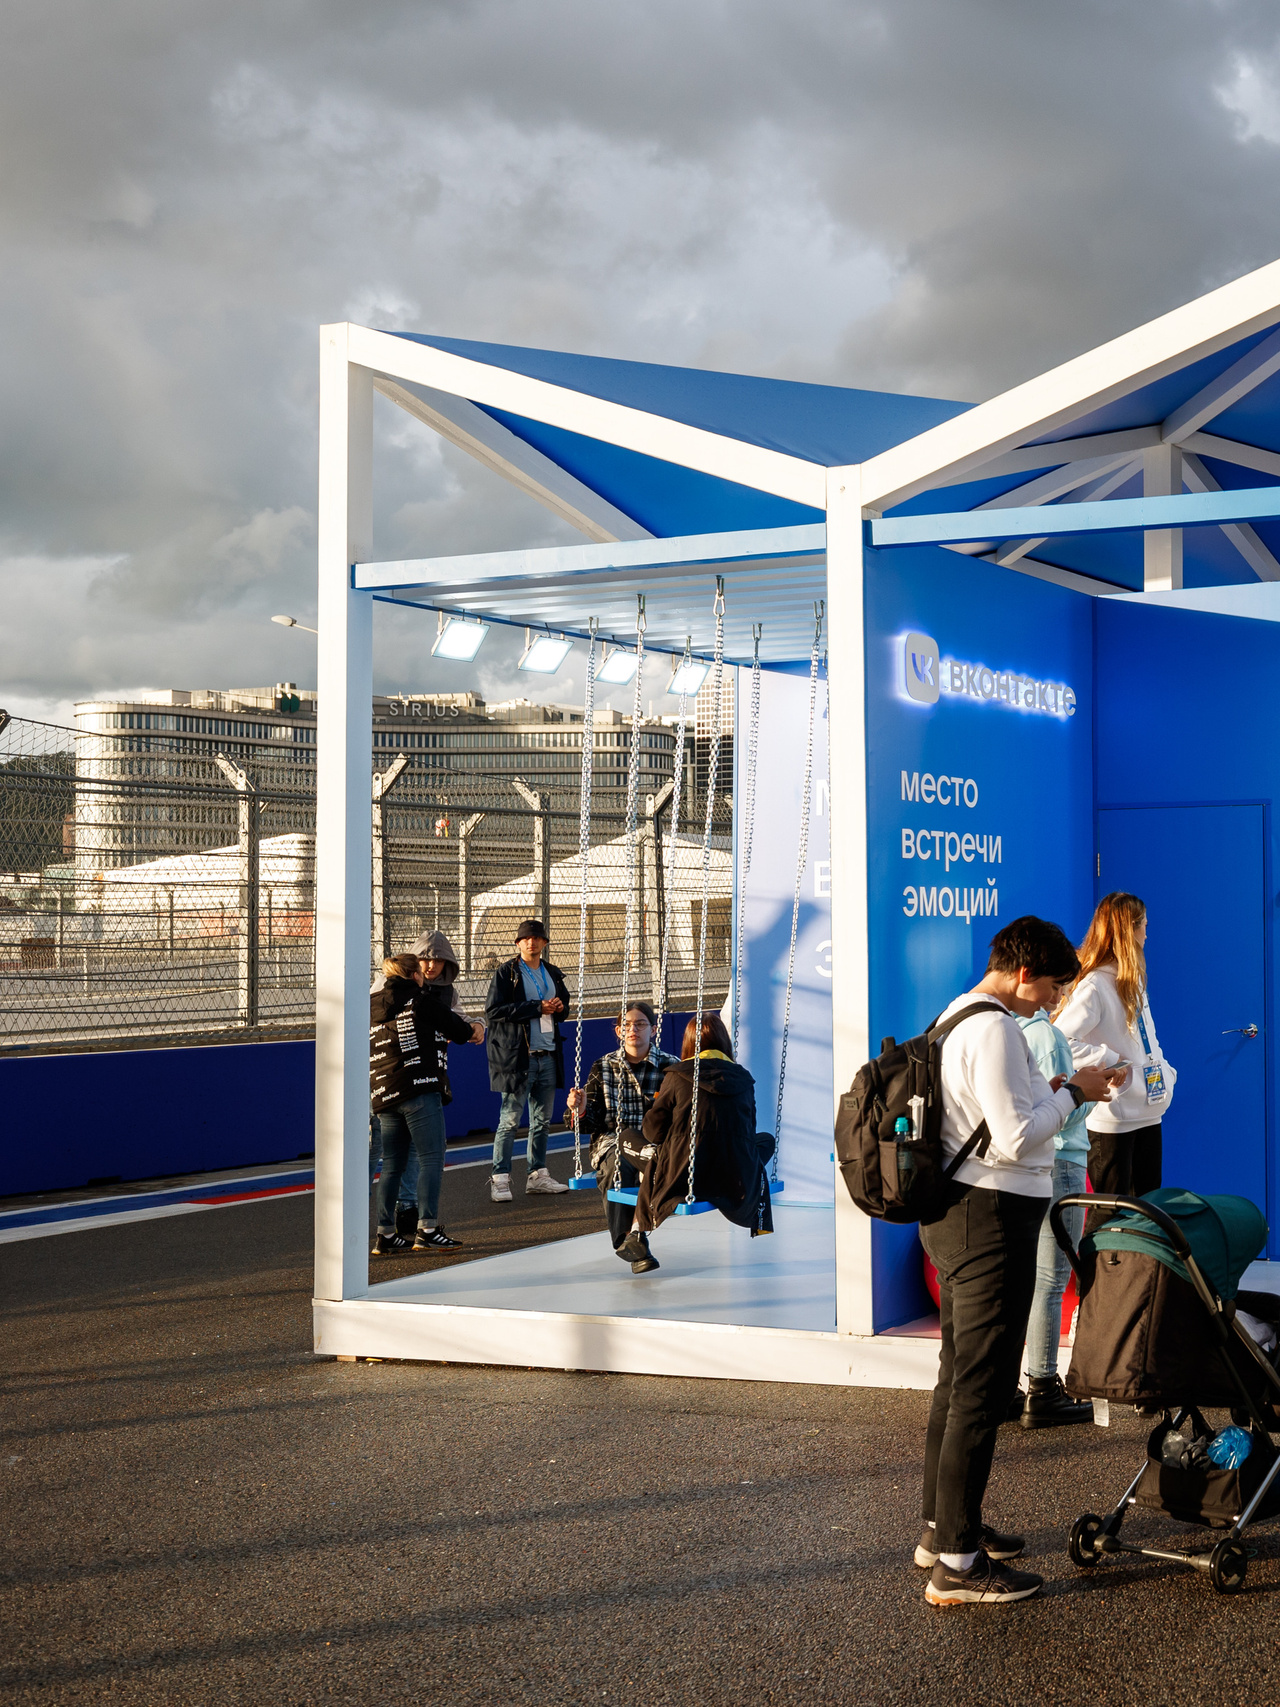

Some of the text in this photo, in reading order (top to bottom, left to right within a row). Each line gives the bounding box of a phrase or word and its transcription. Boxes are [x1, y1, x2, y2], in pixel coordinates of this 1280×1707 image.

[389, 702, 459, 717] SIRIUS
[950, 660, 1077, 717] вконтакте
[901, 770, 979, 808] место
[901, 828, 1002, 872] встречи
[902, 877, 998, 924] эмоций
